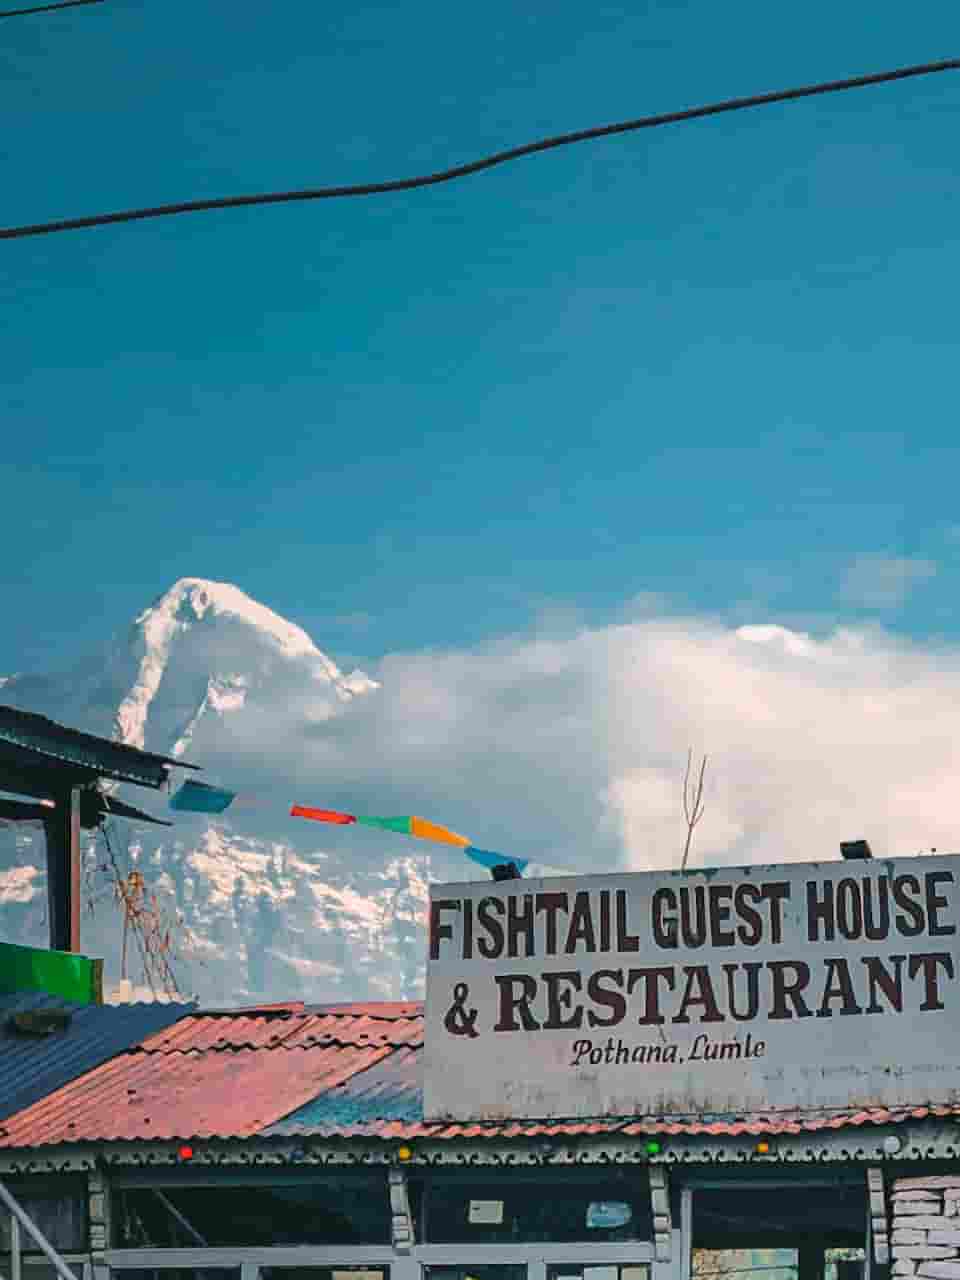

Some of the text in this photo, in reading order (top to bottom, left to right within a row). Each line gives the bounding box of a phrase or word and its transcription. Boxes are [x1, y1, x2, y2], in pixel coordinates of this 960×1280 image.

[430, 871, 956, 960] FISHTAIL GUEST HOUSE
[444, 952, 954, 1038] & RESTAURANT
